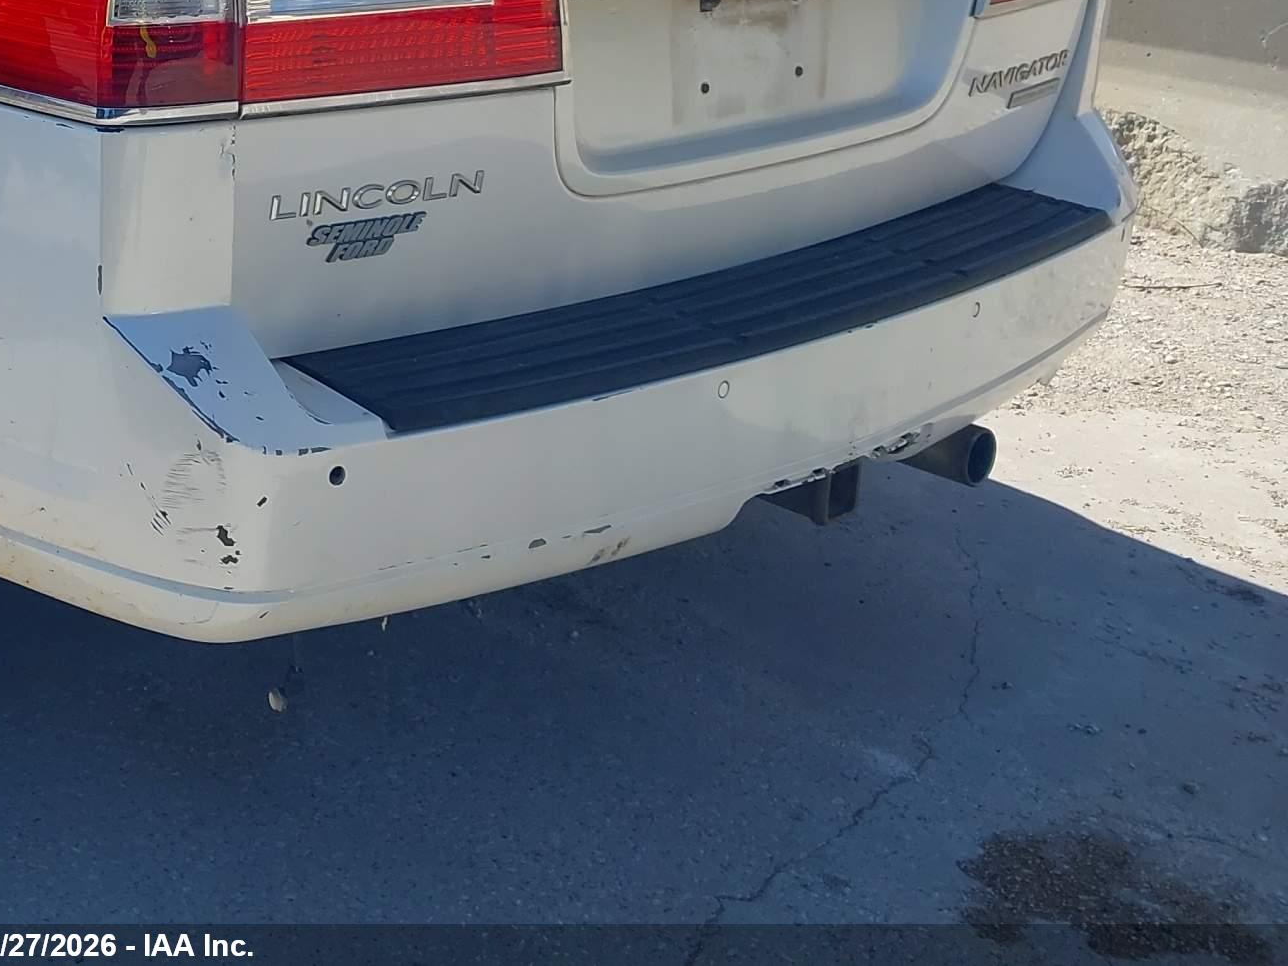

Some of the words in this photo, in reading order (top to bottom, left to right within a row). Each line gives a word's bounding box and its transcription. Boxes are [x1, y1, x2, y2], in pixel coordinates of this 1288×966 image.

[968, 49, 1069, 97] NAVIGATOR
[269, 170, 485, 221] LINCOLN
[306, 211, 427, 246] SEMINOLE
[325, 237, 394, 263] FORD
